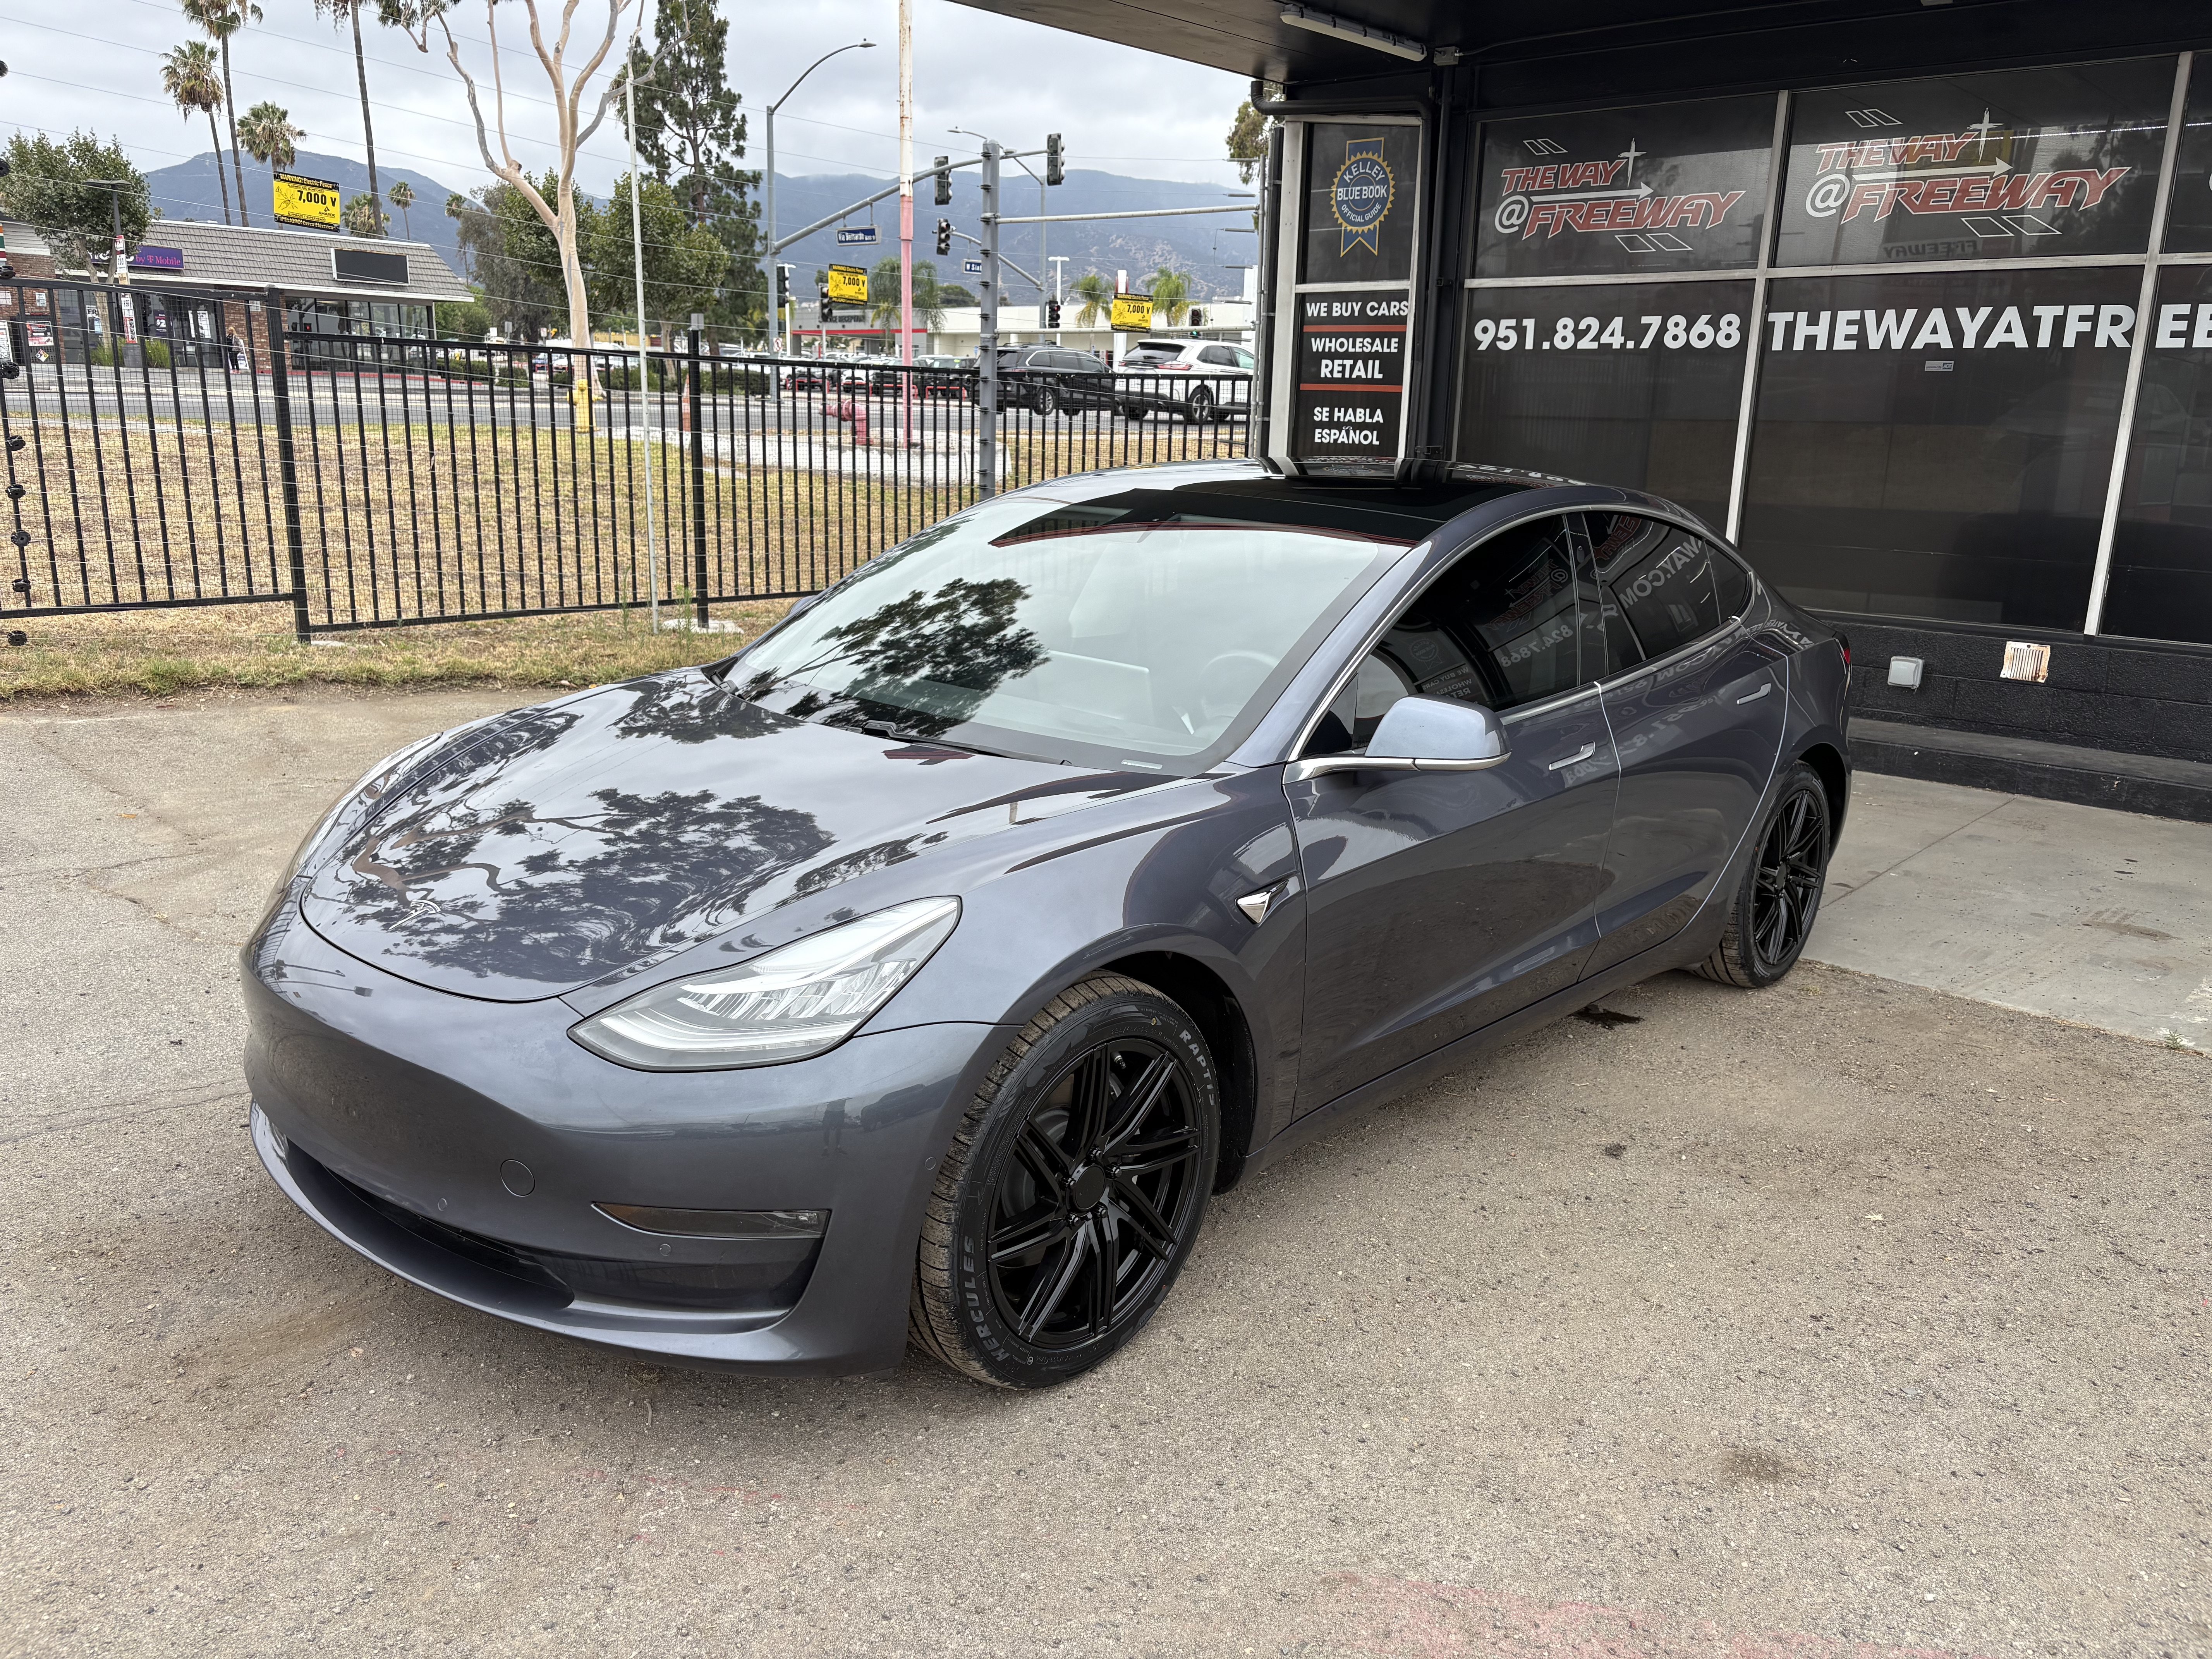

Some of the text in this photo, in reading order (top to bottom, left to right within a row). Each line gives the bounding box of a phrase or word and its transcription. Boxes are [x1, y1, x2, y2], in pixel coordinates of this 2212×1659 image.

[280, 173, 303, 183] WARNING!
[304, 178, 319, 186] Electric
[1343, 161, 1385, 183] KELLEY
[297, 190, 336, 207] 7,000 V
[1337, 185, 1387, 201] BLUE BOOK
[1341, 202, 1382, 223] OFFICIAL GUIDE
[136, 255, 145, 264] by
[155, 256, 181, 265] Mobile
[843, 276, 860, 287] 7,000
[1127, 304, 1151, 314] 7,000 V
[1306, 301, 1408, 317] WE BUY CARS
[1474, 313, 1741, 351] 951.824.7868
[1311, 337, 1399, 353] WHOLESALE
[1321, 359, 1383, 379] RETAIL
[1313, 407, 1384, 423] SE HABLA
[1179, 1029, 1215, 1106] RAPTIS
[963, 1235, 1010, 1361] HERCULES
